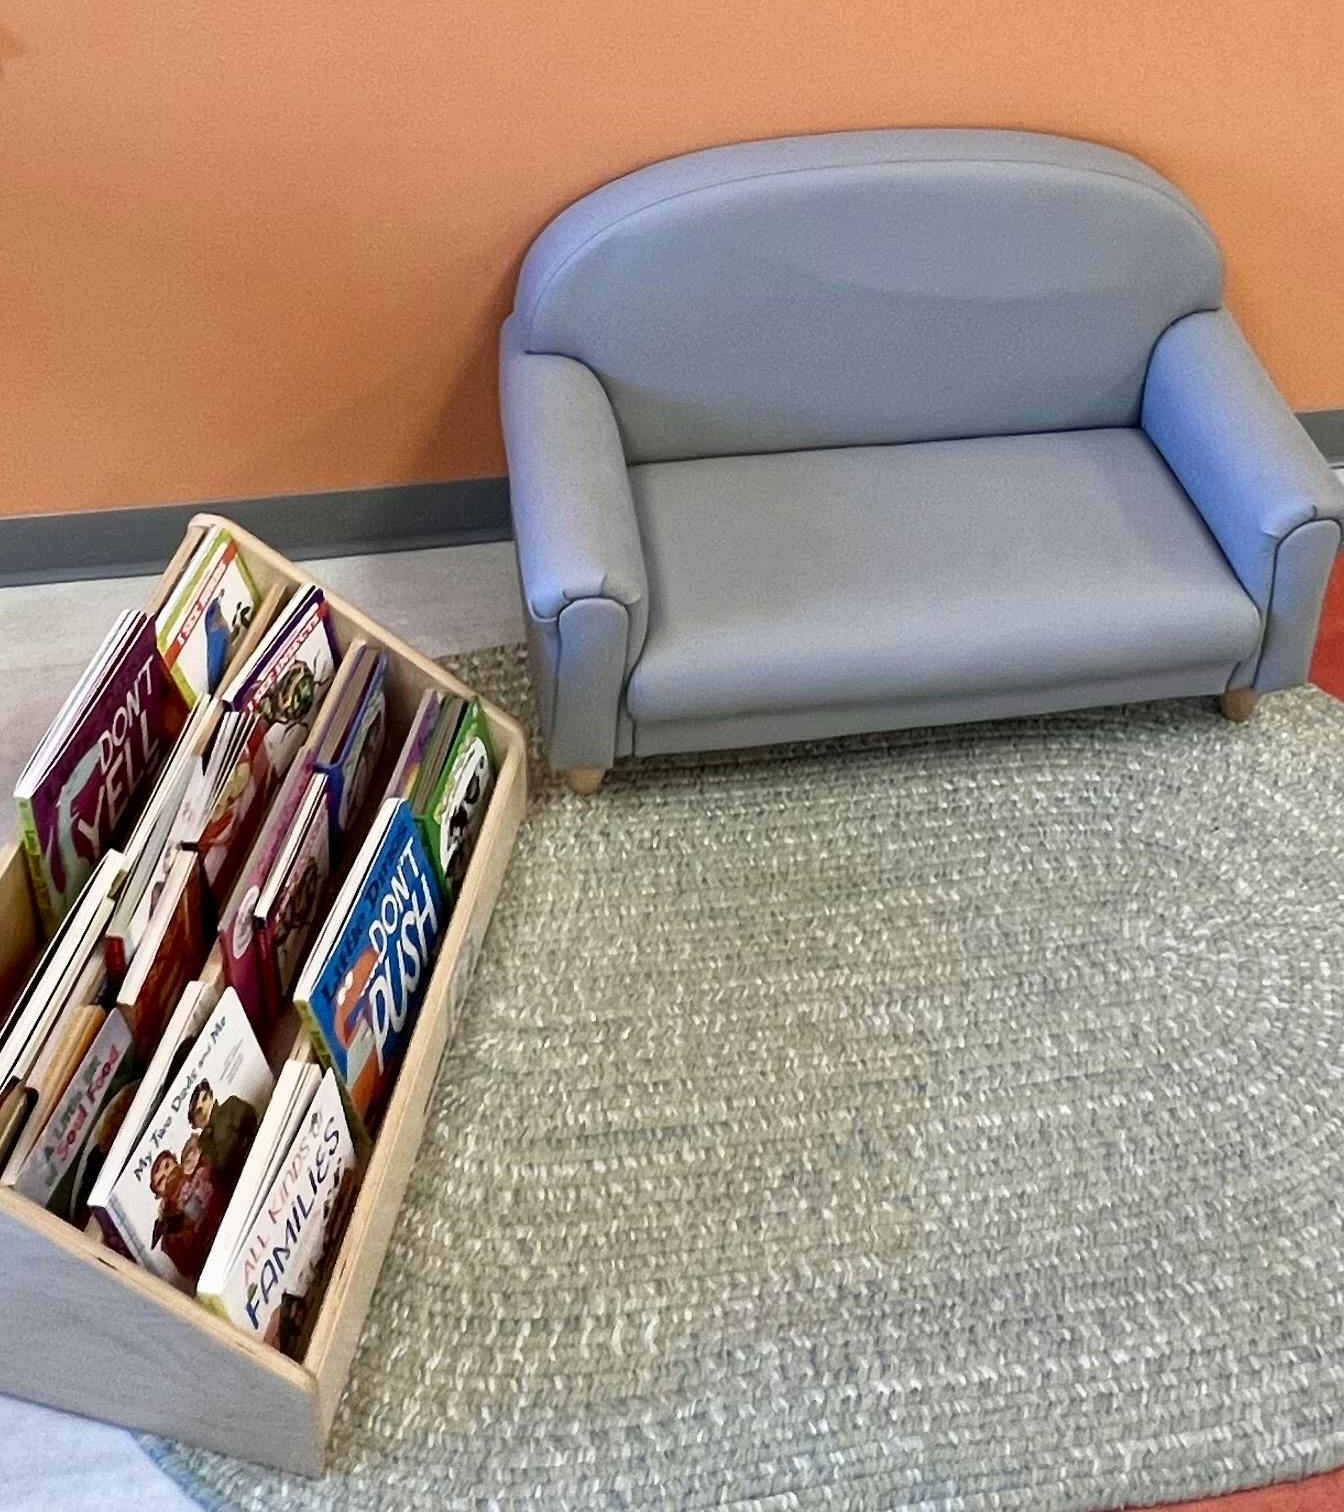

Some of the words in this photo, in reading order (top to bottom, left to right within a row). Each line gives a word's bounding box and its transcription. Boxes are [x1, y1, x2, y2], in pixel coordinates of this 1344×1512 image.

[97, 655, 153, 774] DON'T
[75, 709, 160, 859] YELL
[366, 837, 418, 962] DON'T
[370, 873, 438, 1075] PUSH
[54, 1103, 88, 1161] Soul
[86, 1045, 121, 1103] Food
[133, 1150, 151, 1181] My
[149, 1115, 173, 1148] Two
[170, 1069, 197, 1112] Dads
[210, 1015, 227, 1044] Me
[242, 1231, 270, 1285] ALL
[244, 1116, 341, 1329] FAMILIES
